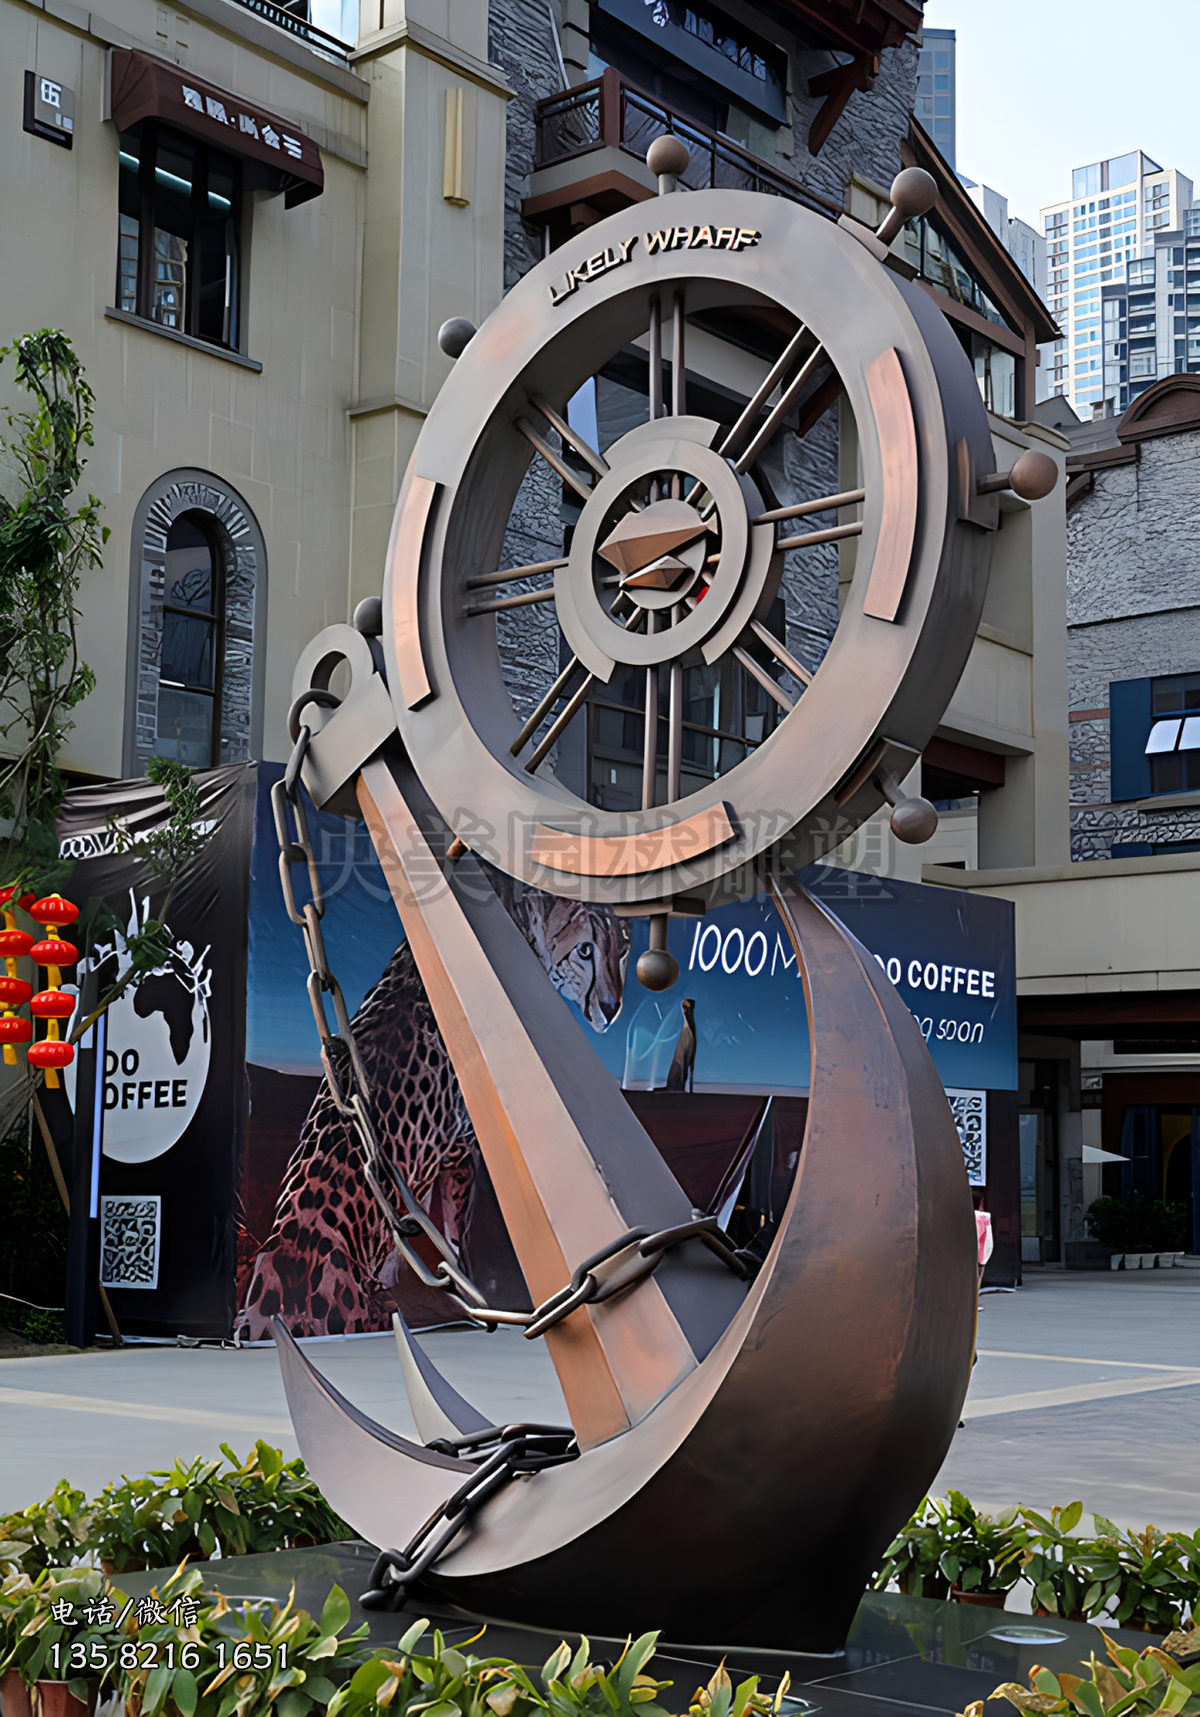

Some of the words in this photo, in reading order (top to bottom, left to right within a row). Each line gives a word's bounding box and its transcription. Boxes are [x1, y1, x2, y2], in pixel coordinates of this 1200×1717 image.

[908, 960, 995, 998] COFFEE
[935, 1018, 984, 1043] soon
[104, 1079, 188, 1110] OFFEE
